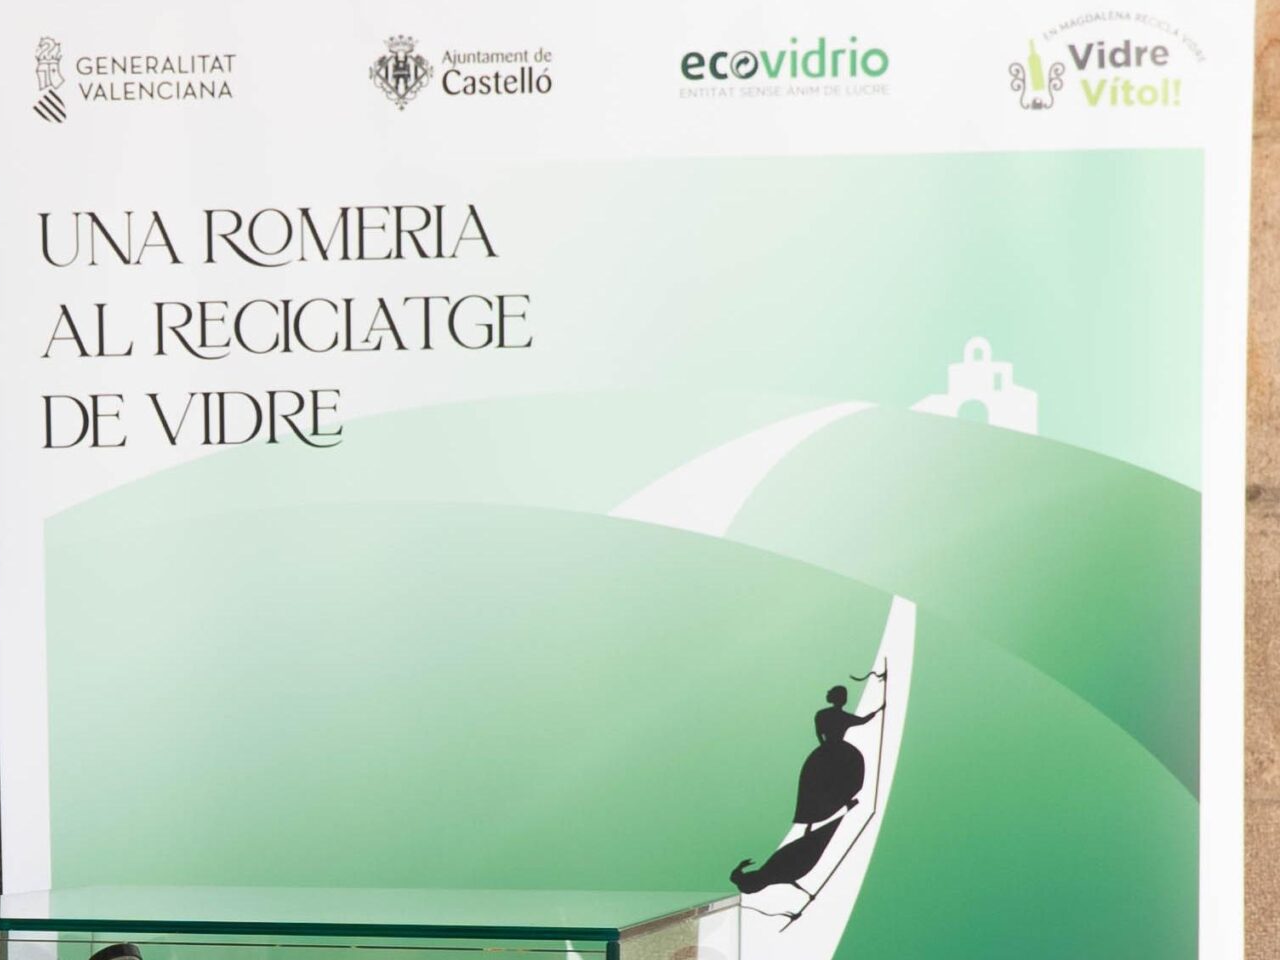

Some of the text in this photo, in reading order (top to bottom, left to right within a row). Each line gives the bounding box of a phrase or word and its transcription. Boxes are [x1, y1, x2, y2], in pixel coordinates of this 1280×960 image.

[1058, 10, 1131, 31] MAGDALENA
[76, 54, 236, 75] GENERALITAT
[441, 47, 552, 68] Ajuntament de
[680, 36, 890, 80] ecovidrio
[1068, 39, 1170, 71] Vidre
[78, 80, 234, 101] VALENCIANA
[442, 66, 553, 95] Castelló
[679, 87, 735, 99] ENTITAT
[739, 85, 779, 97] SENSE
[823, 84, 841, 96] DE
[846, 83, 890, 96] LUCRE
[1080, 76, 1182, 107] Vítol!
[37, 204, 499, 267] UNA ROMERIA
[40, 294, 534, 360] AL RECICLATGE
[41, 389, 344, 449] DE VIDRE
